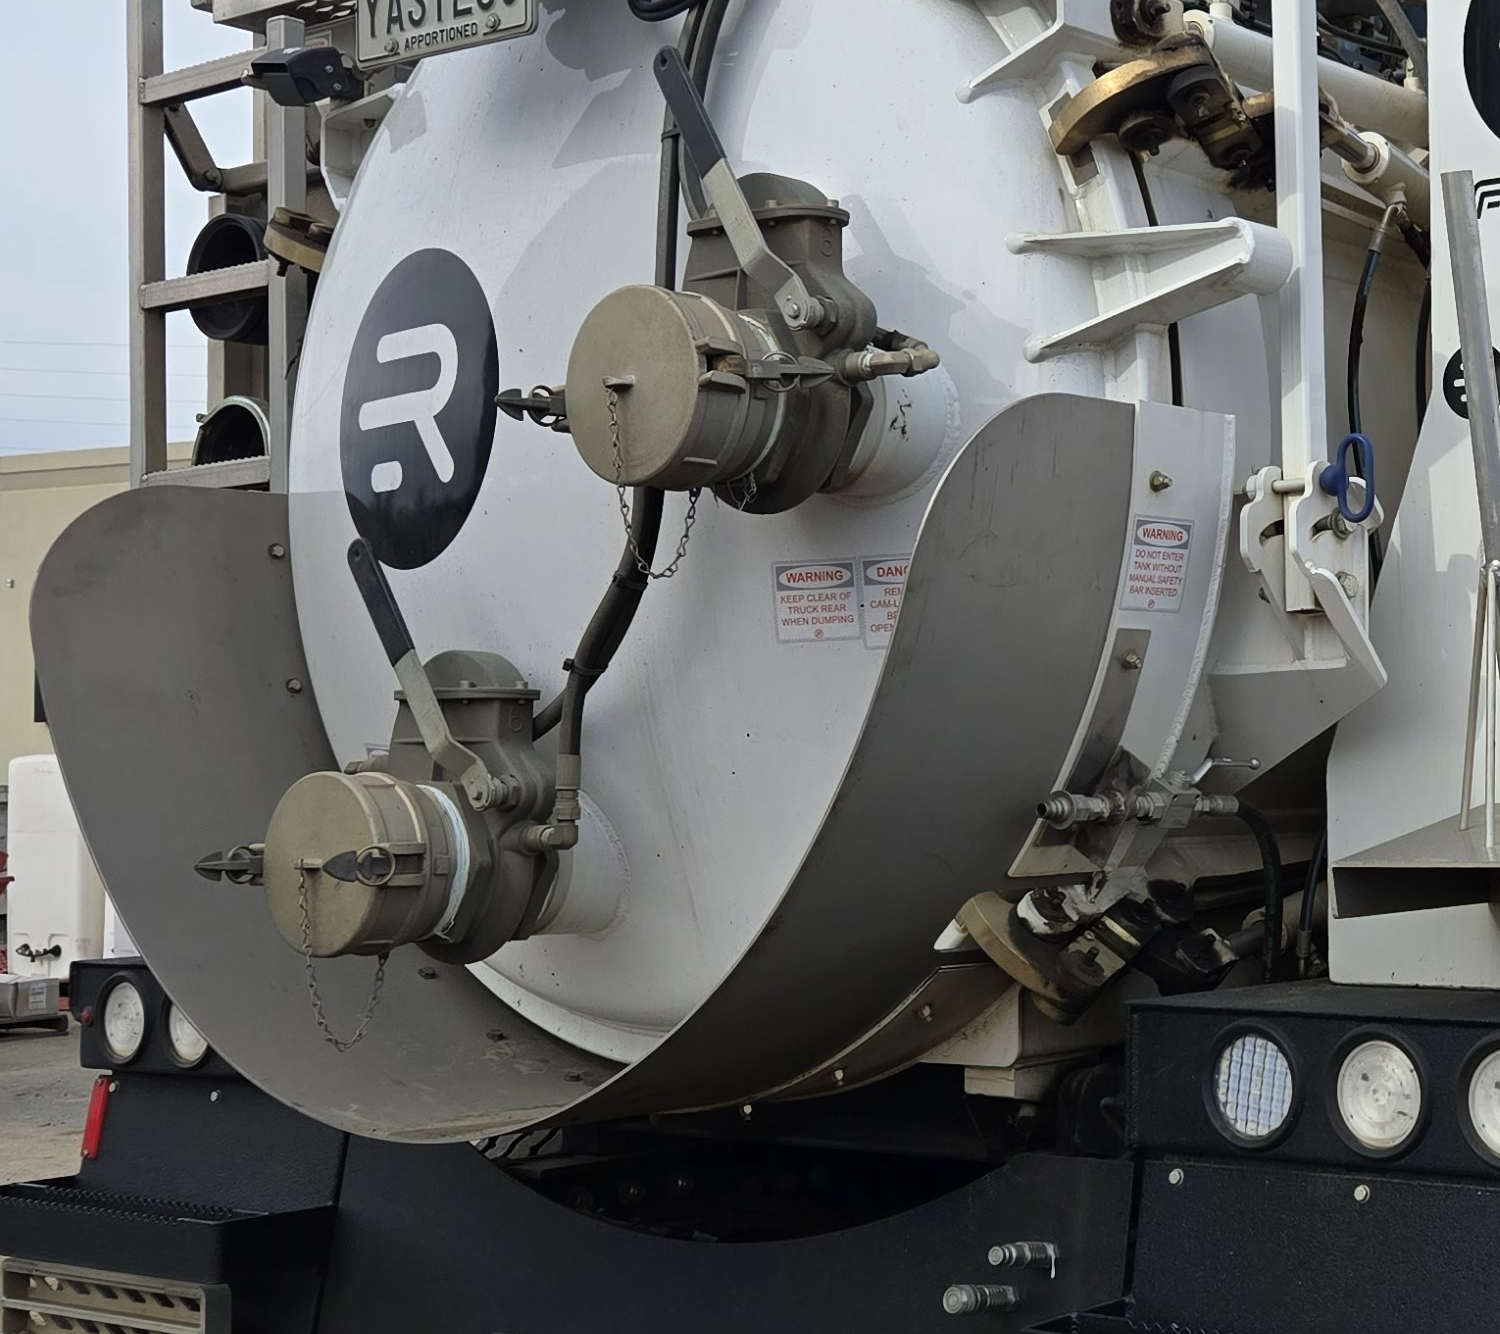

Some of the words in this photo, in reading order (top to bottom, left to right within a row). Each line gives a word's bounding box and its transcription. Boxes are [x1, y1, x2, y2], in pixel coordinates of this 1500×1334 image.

[404, 21, 478, 52] APPORTIONED
[1142, 527, 1184, 542] WARNING
[1135, 549, 1146, 558] DO
[1147, 550, 1161, 560] NOT
[1162, 552, 1184, 562] ENTER
[877, 564, 909, 578] DAN
[1134, 561, 1151, 571] TANK
[1152, 563, 1183, 574] WITHOUT
[785, 570, 844, 584] WARNING
[1129, 573, 1156, 584] MANUAL
[1157, 575, 1183, 586] SAFETY
[780, 594, 804, 604] KEEP
[806, 592, 837, 603] CLEAR
[838, 591, 852, 601] OF
[1129, 585, 1144, 595] BAR
[1144, 586, 1177, 597] INSERTED
[788, 605, 819, 615] TRUCK
[820, 603, 847, 613] REAR
[782, 616, 809, 627] WHEN
[811, 613, 854, 625] DUMPING
